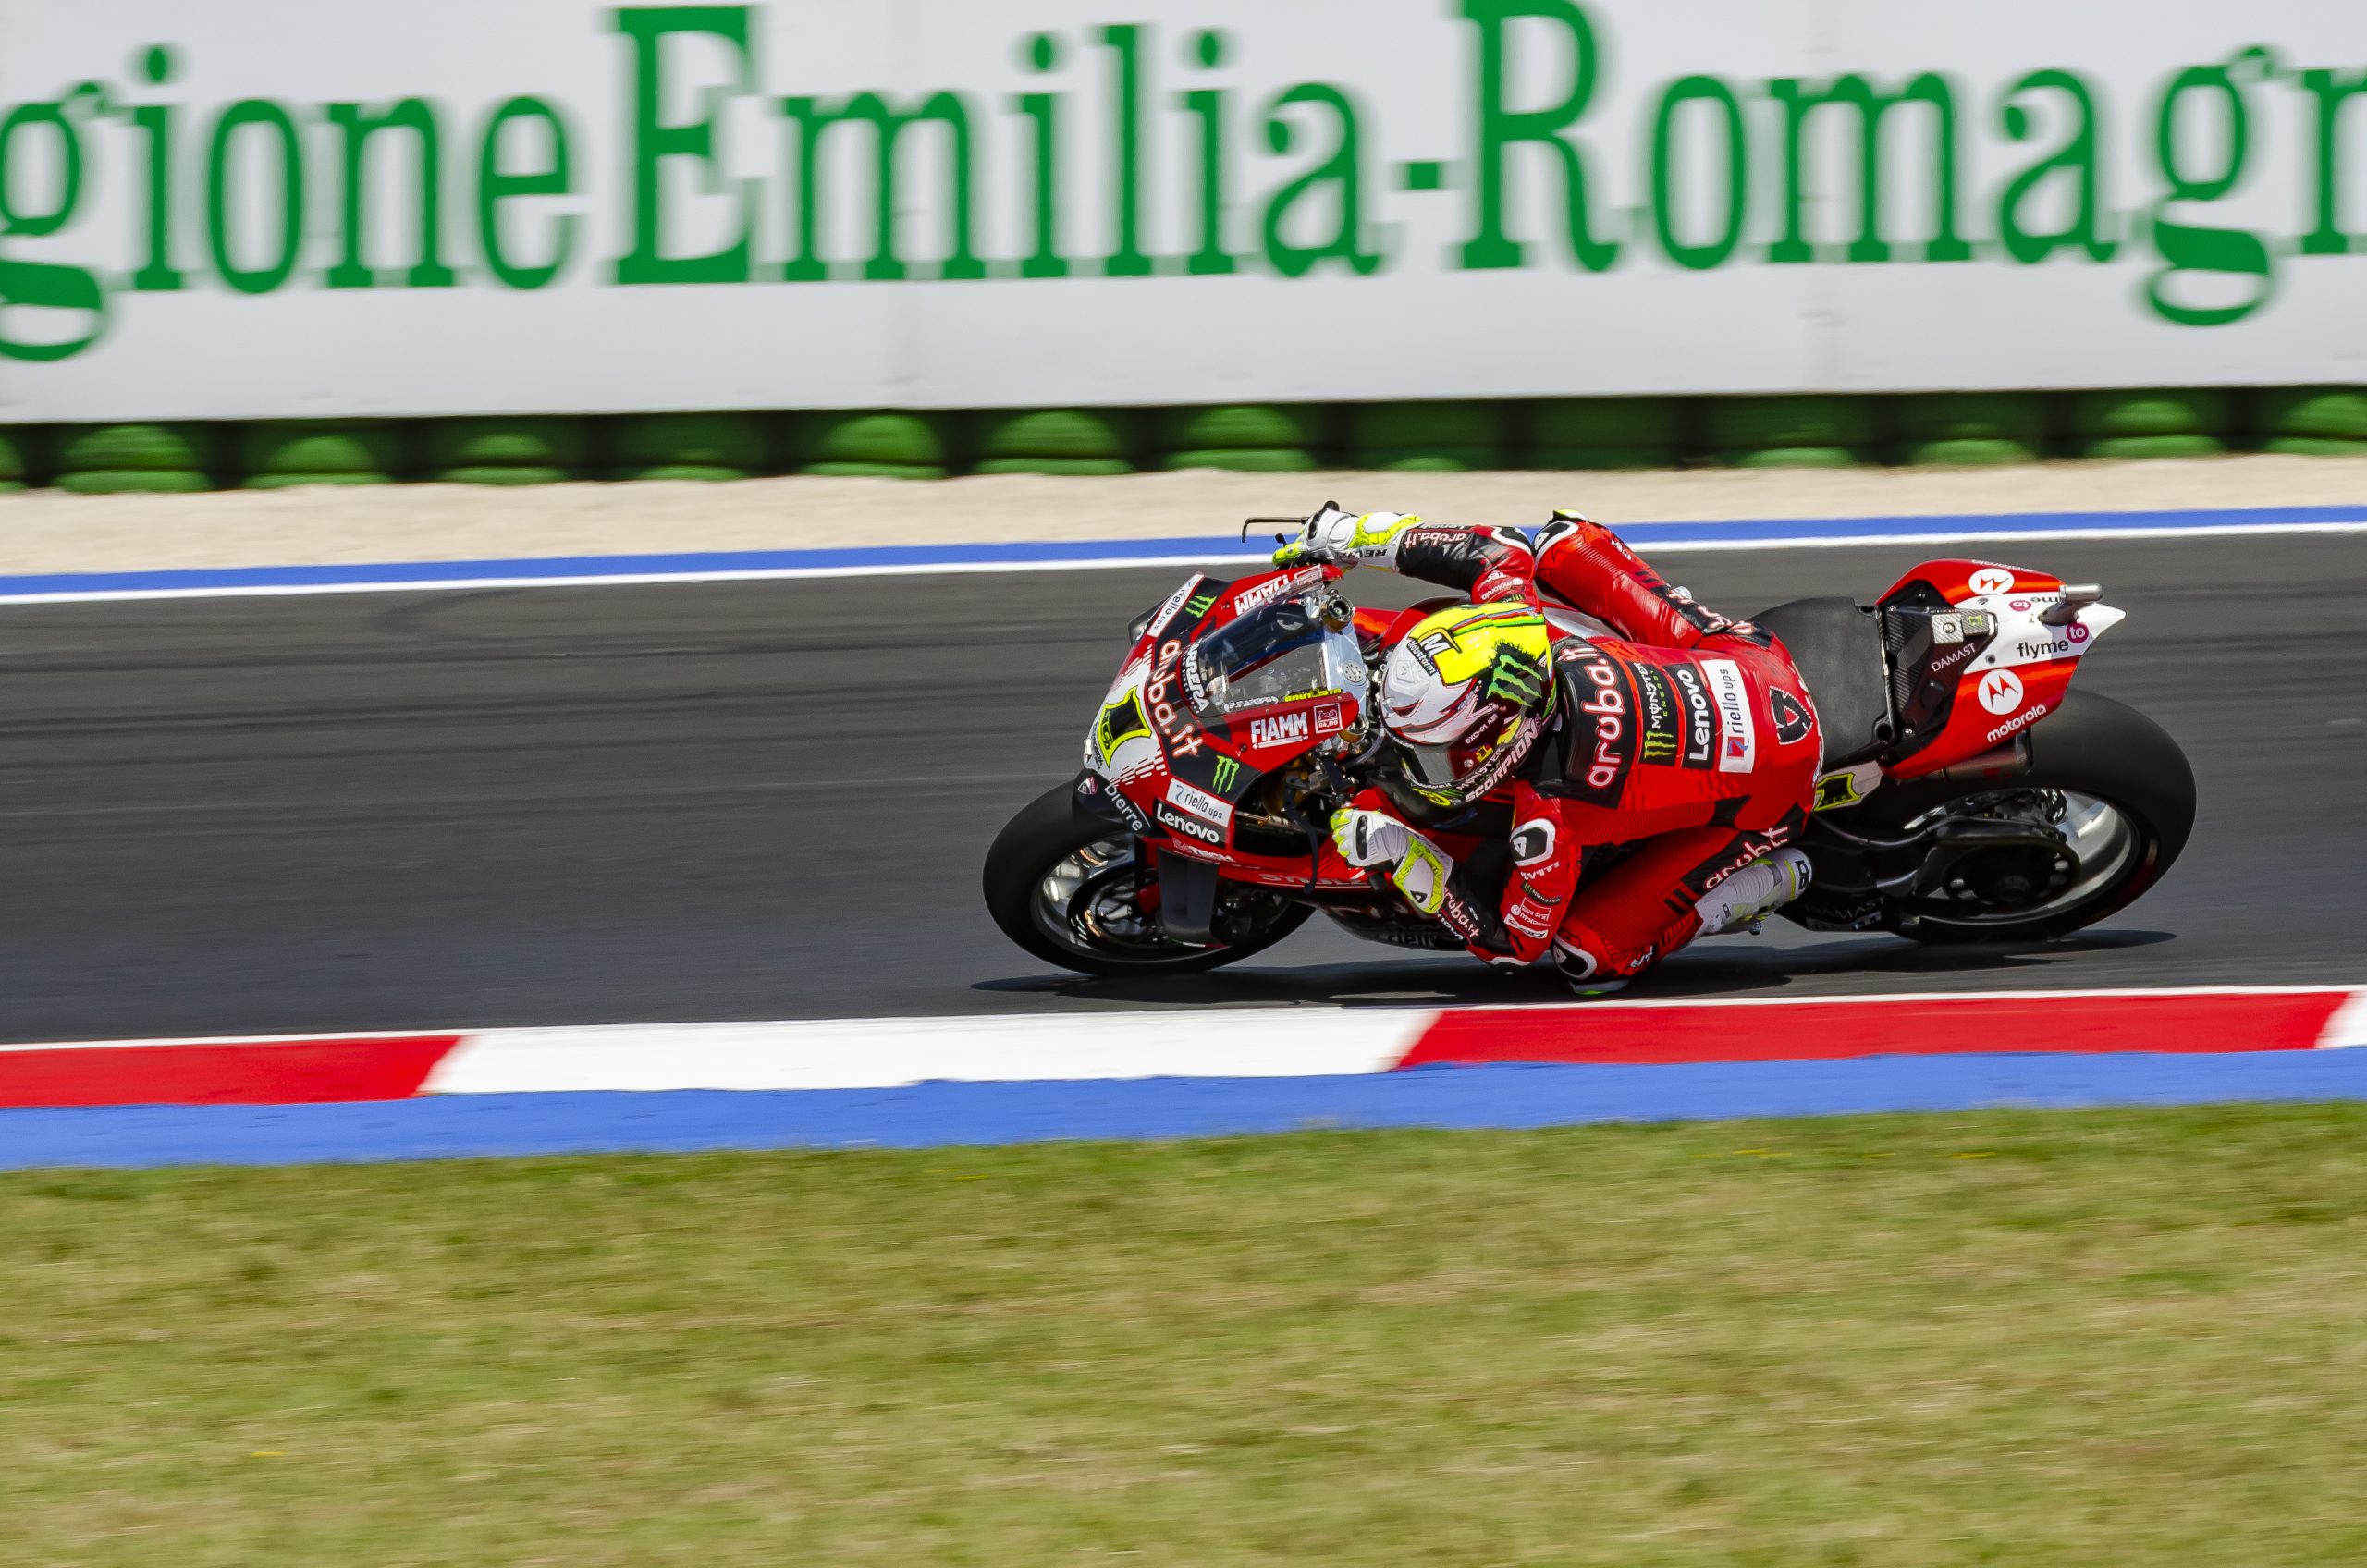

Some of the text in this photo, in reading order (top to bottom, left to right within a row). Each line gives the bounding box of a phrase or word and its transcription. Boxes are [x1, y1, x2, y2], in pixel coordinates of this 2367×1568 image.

[0, 42, 588, 362] gione
[1931, 643, 1977, 673] DAMAST
[2017, 624, 2087, 659] flyme to
[1184, 636, 1210, 712] ARRERA
[1560, 646, 1625, 788] aruba.it
[1677, 669, 1710, 761] Lenovo
[1720, 668, 1745, 735] riello ups
[1987, 704, 2047, 743] motorola
[1251, 711, 1309, 744] FIAMM
[1466, 719, 1540, 802] SCORPION
[1157, 803, 1220, 844] Lenovo
[1184, 790, 1223, 820] riello ups
[1443, 888, 1480, 937] ruba.it
